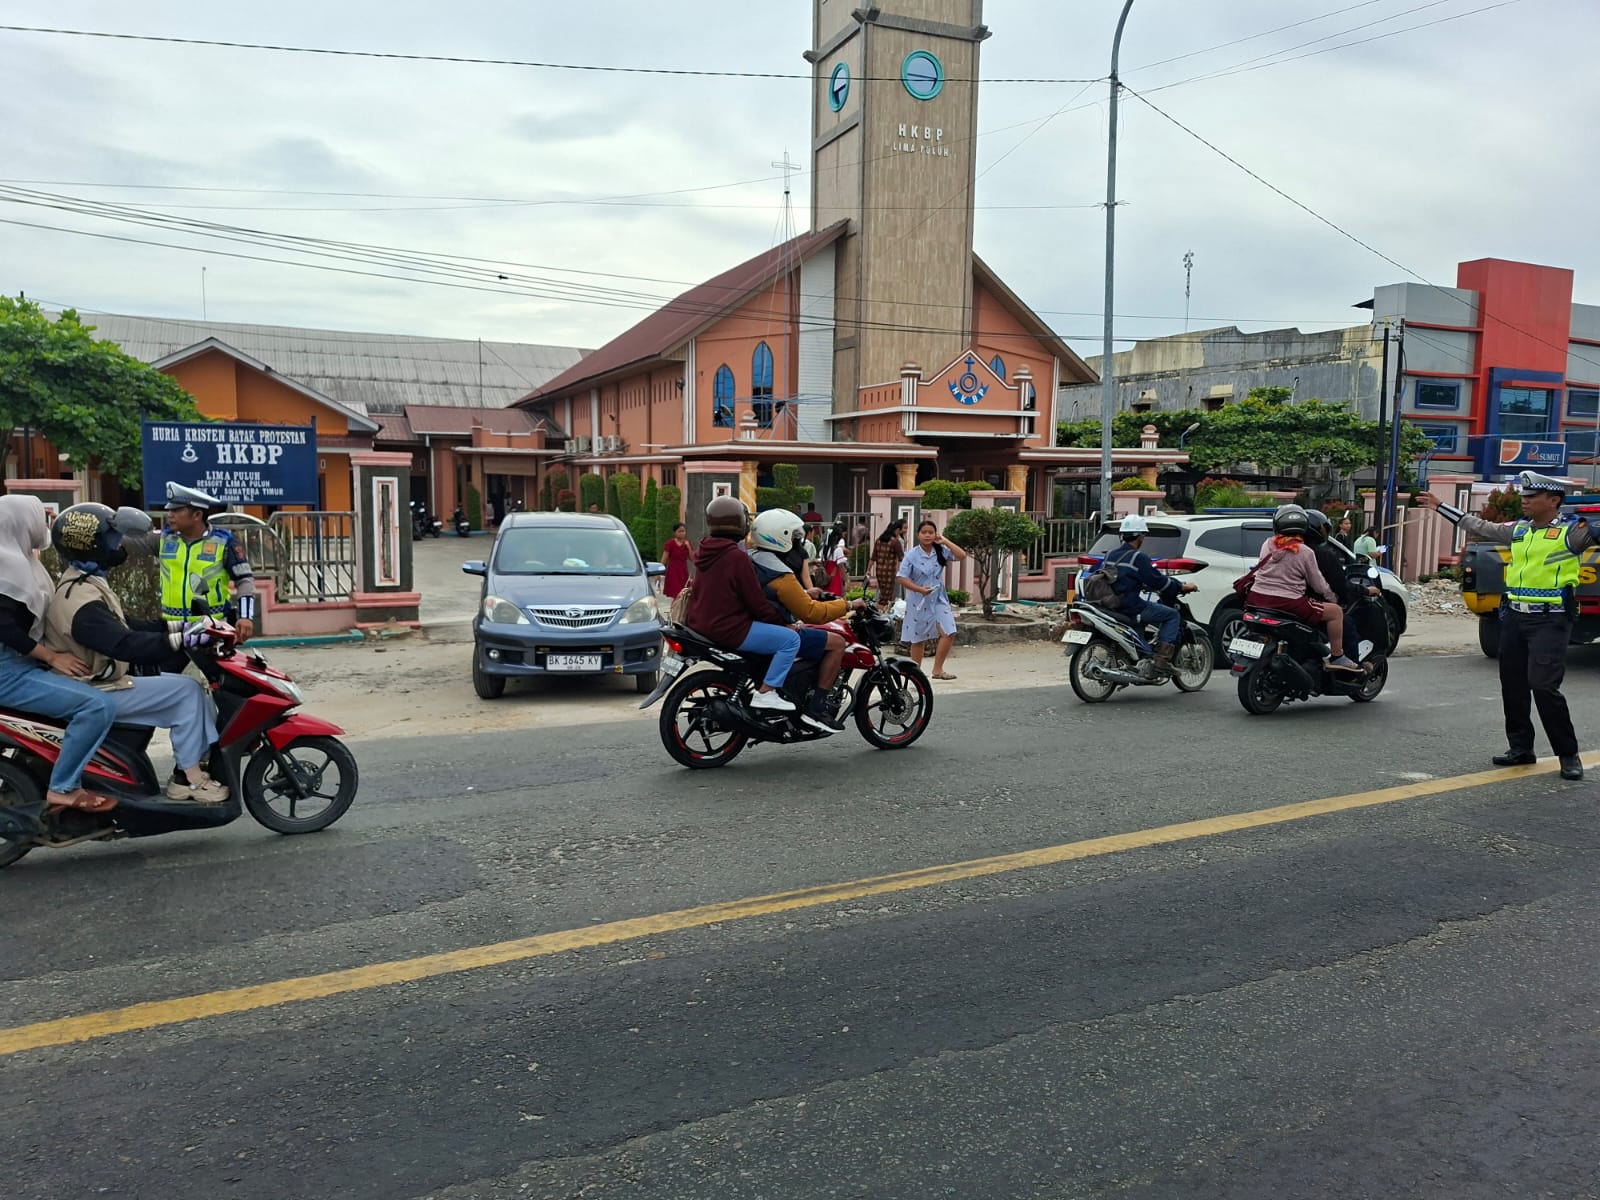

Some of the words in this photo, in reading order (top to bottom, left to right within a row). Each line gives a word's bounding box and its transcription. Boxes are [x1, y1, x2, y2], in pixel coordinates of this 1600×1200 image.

[898, 123, 943, 141] HKBP
[893, 141, 915, 153] LIMA
[920, 145, 949, 157] PULUH
[951, 387, 985, 403] HKBP
[152, 427, 180, 442] HURIA
[185, 428, 225, 443] KRISTEN
[228, 430, 256, 444] BATAK
[259, 430, 306, 445] PROTESTAN
[216, 444, 283, 465] HKBP
[206, 471, 231, 481] LIMA
[233, 471, 261, 481] PULUH
[224, 488, 259, 496] SUMATERA
[262, 488, 284, 496] TIMUR
[548, 655, 560, 665] BK
[562, 655, 585, 665] 1645
[588, 655, 599, 665] KY
